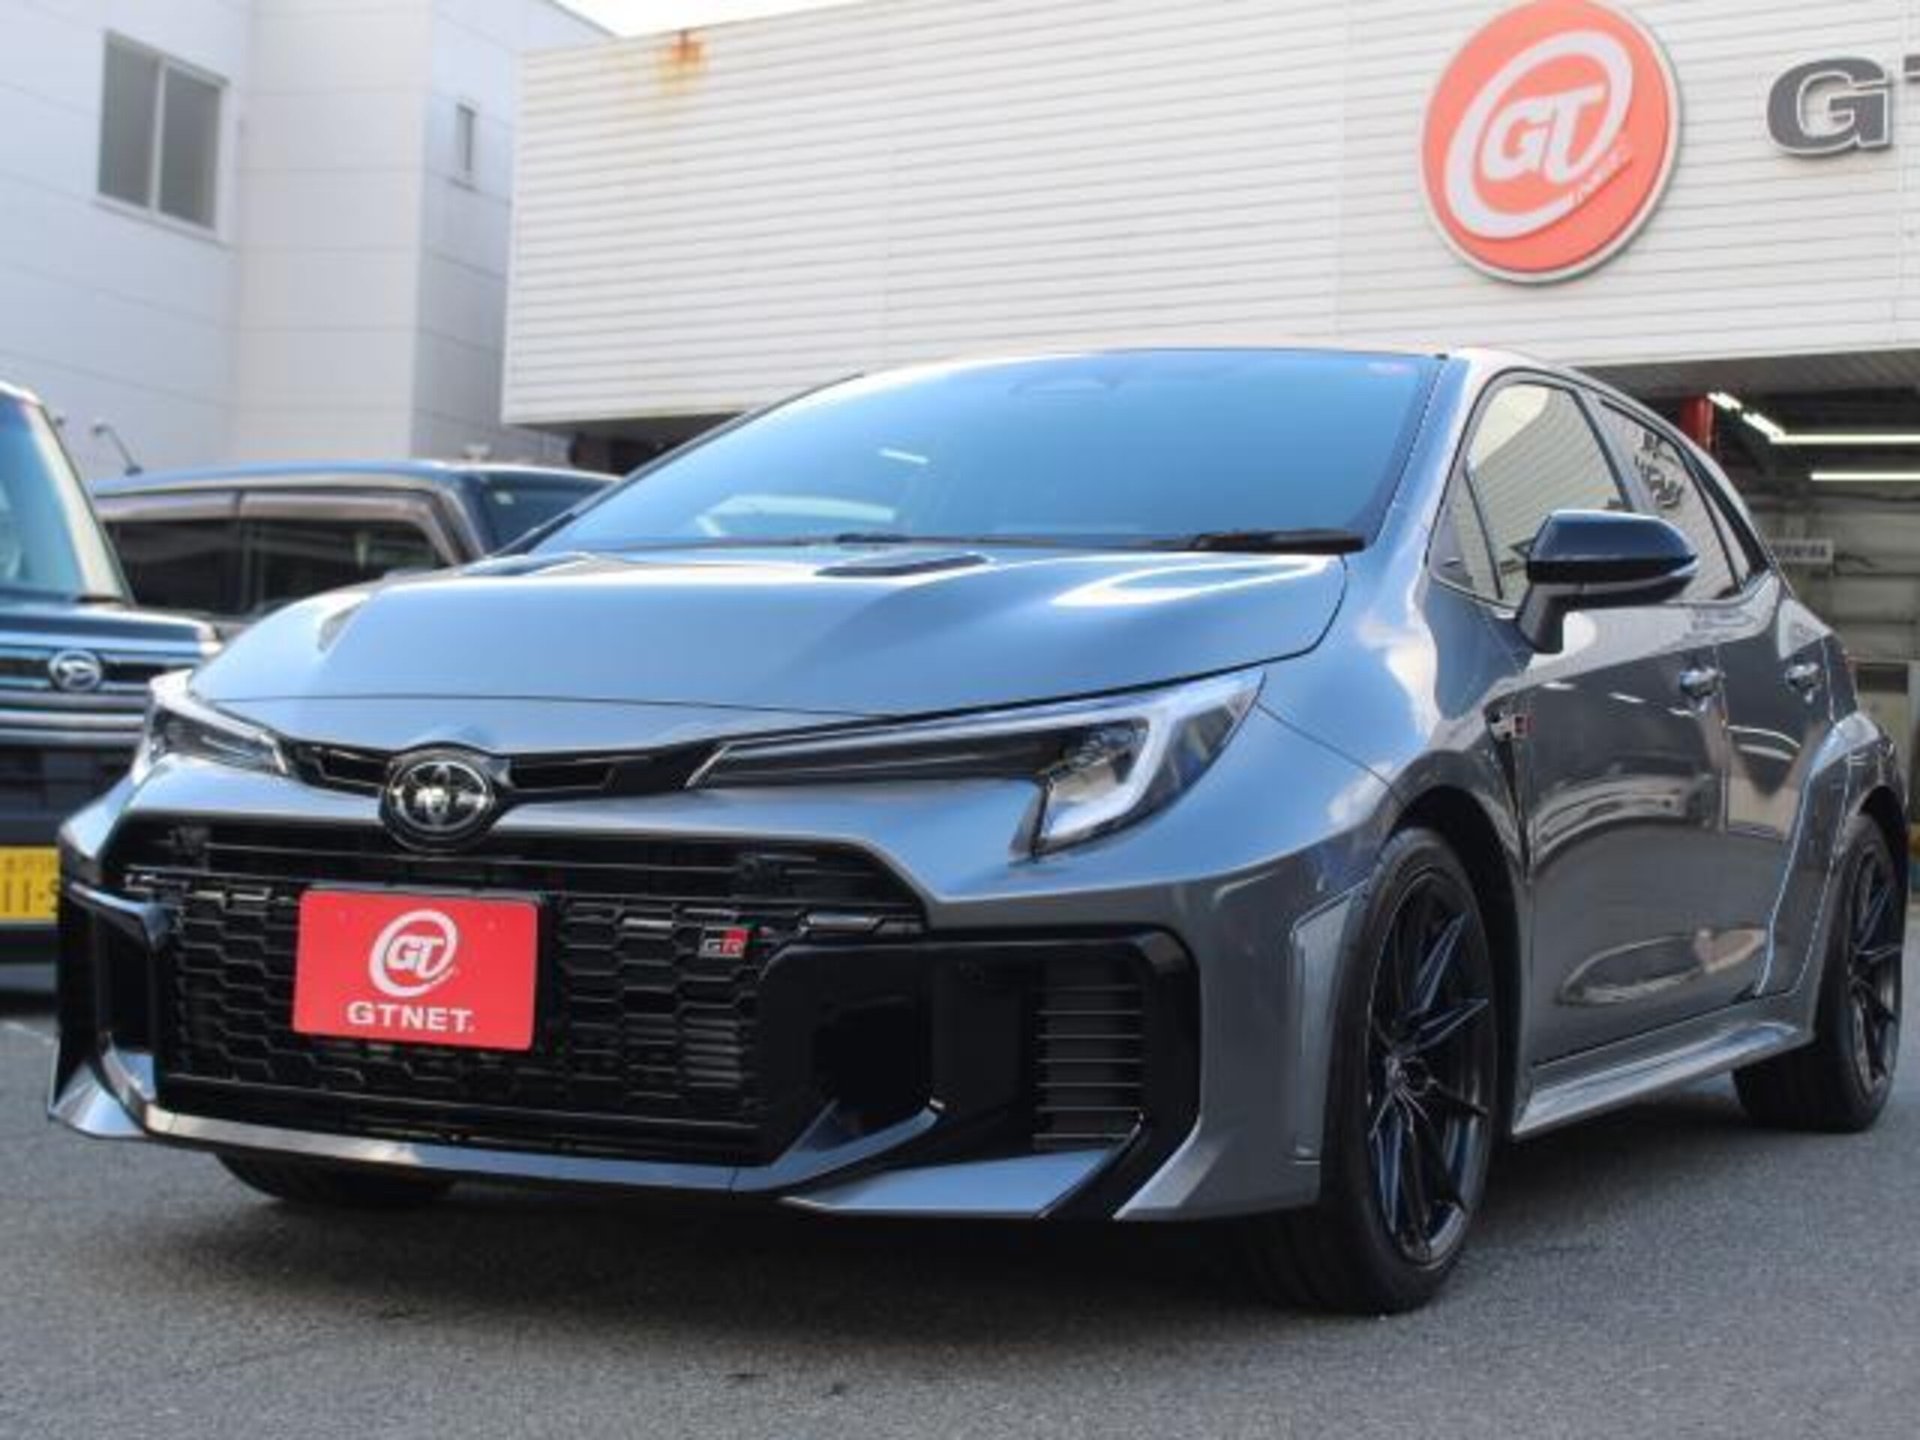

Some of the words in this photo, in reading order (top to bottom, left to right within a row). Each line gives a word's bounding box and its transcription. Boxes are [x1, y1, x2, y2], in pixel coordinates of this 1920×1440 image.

[1766, 54, 1920, 155] G
[699, 926, 747, 957] GR
[347, 1000, 474, 1034] GTNET
